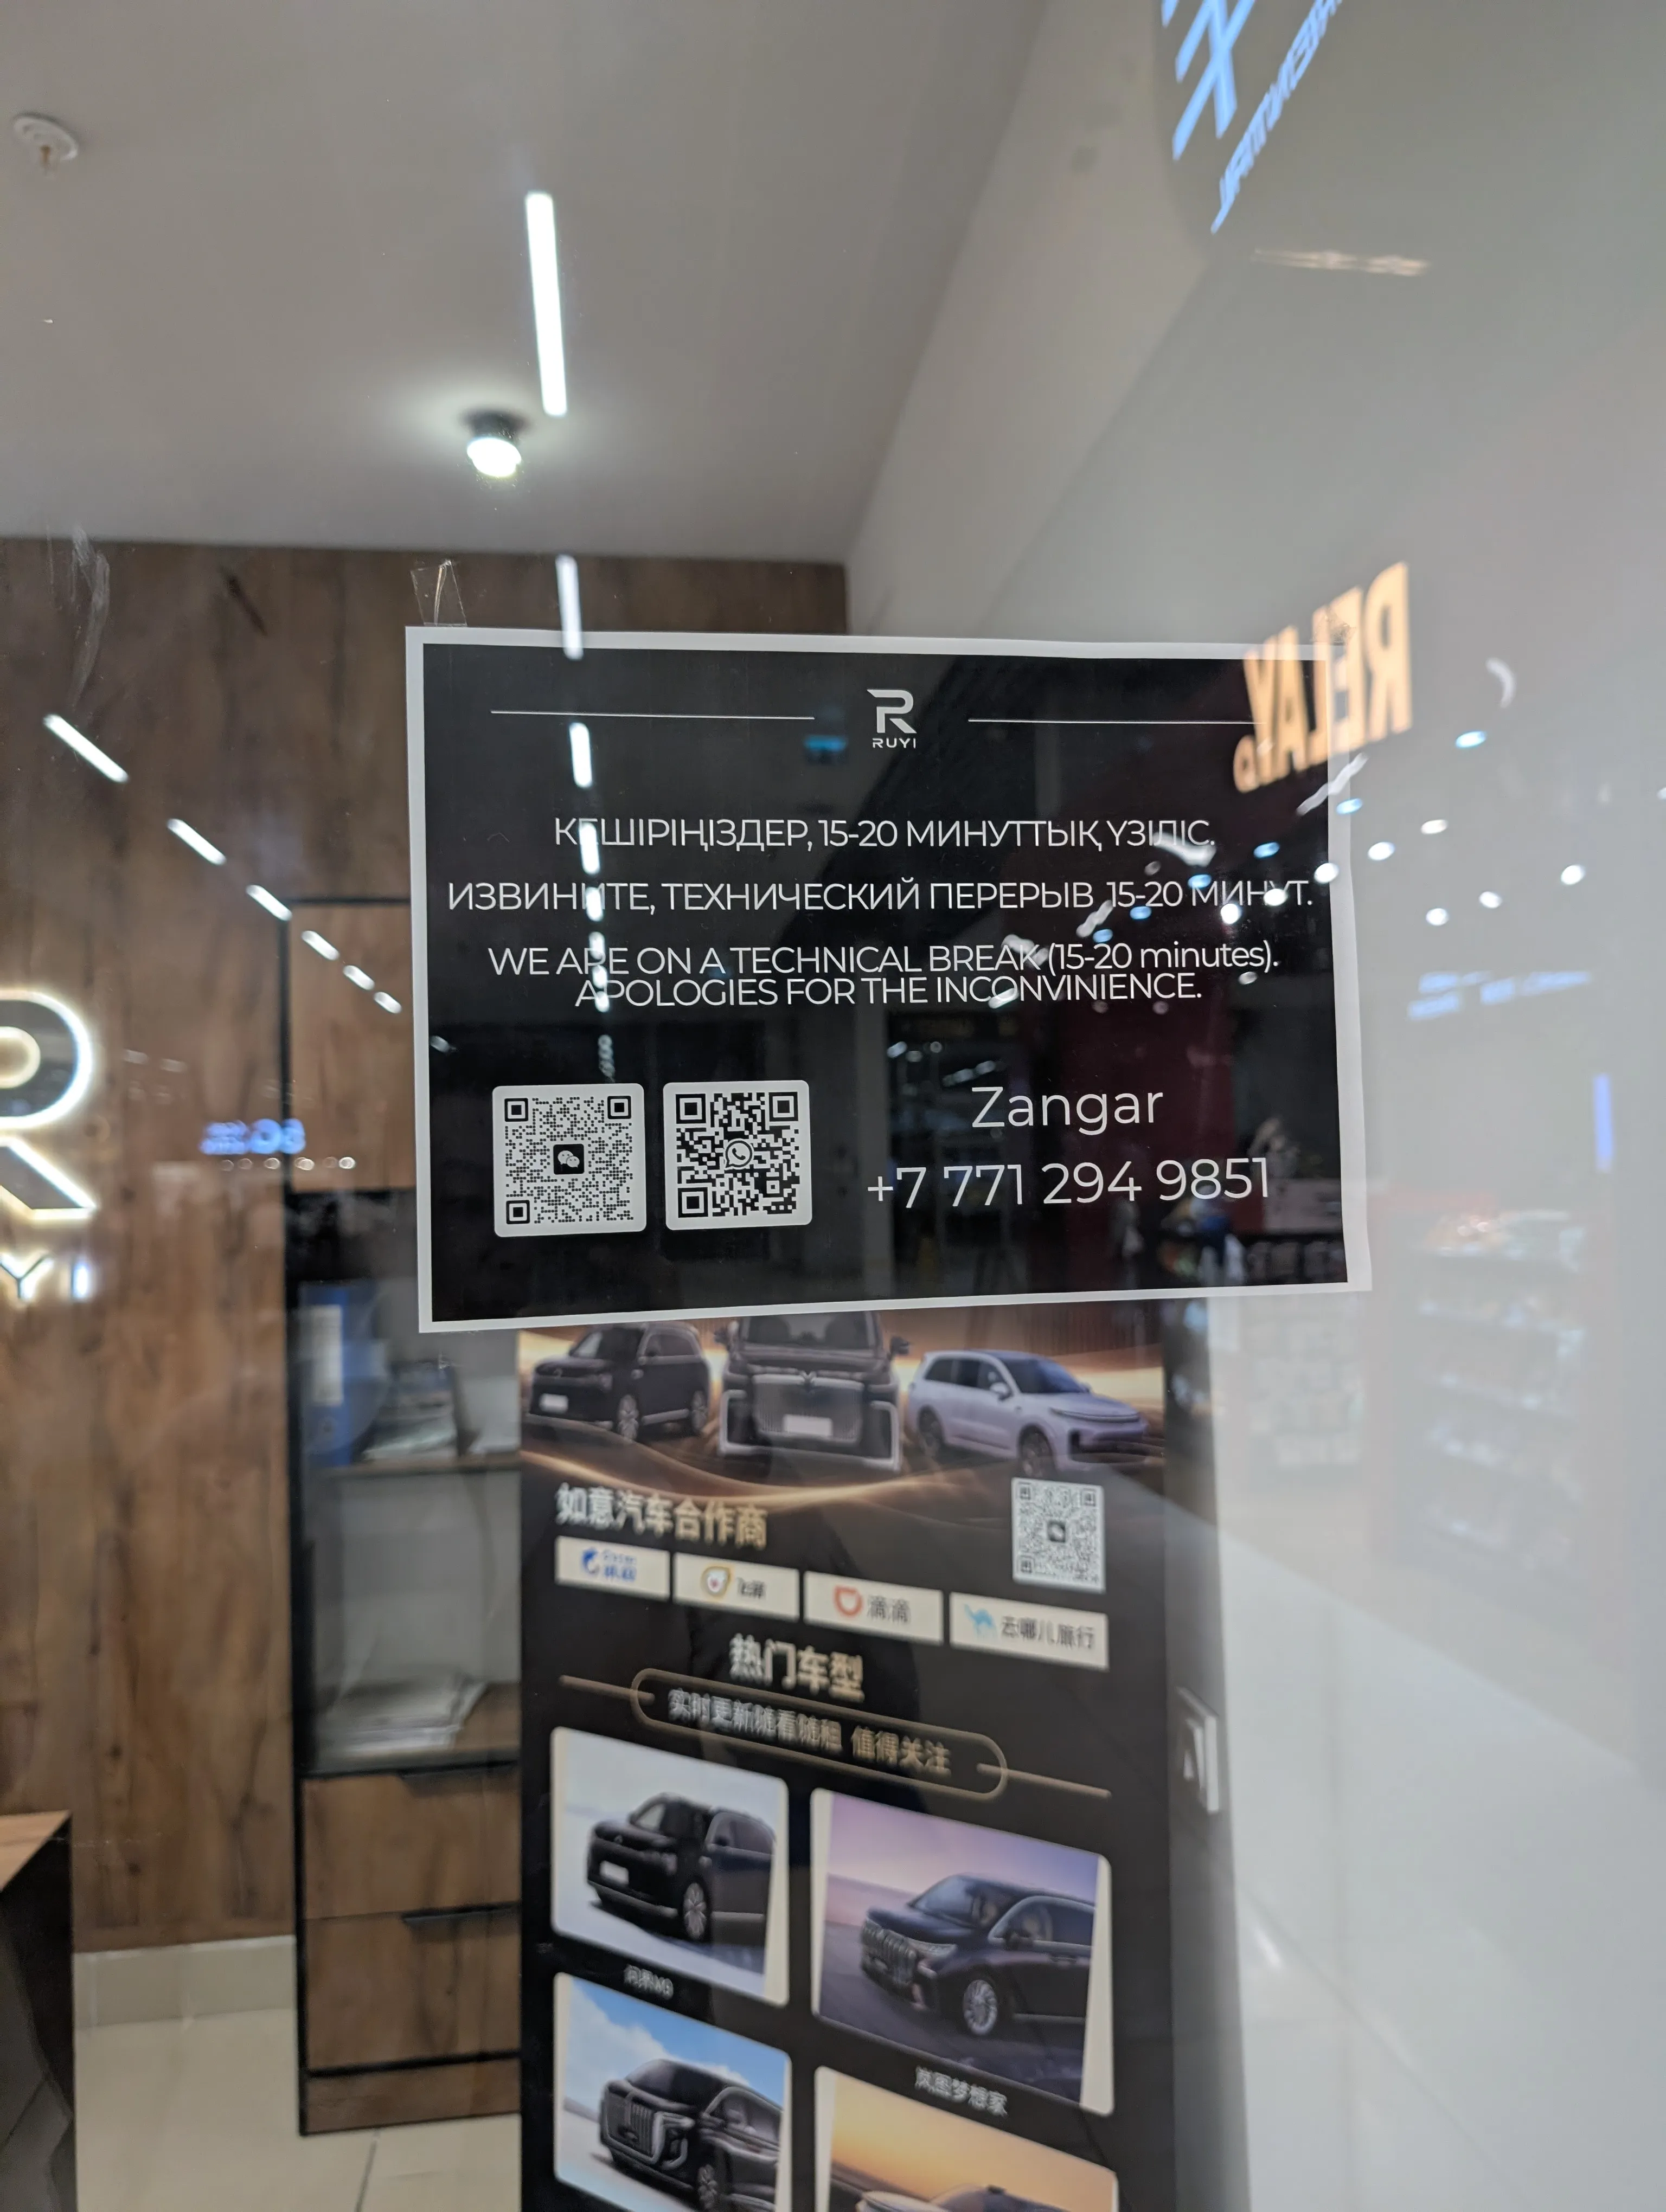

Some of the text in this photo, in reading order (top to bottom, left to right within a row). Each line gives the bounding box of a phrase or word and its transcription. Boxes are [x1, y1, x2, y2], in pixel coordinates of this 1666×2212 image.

[872, 738, 917, 749] RUYI
[818, 819, 898, 847] 15-20
[907, 820, 1102, 851] МИНУТТЫҚ
[661, 878, 919, 911] ТЕХНИЧЕСКИЙ
[930, 882, 1093, 910] ПЕРЕРЫВ
[1106, 880, 1183, 908] 15-20
[488, 940, 1279, 975] WE ARE ON A TECHNICAL BREAK (15-20 minutes).
[575, 973, 1202, 1007] APOLOGIES FOR THE INCONVINIENCE.
[971, 1086, 1164, 1136] Zangar
[868, 1156, 1269, 1208] +7 771 294 9851
[556, 1483, 768, 1552] 如意汽车合作商
[728, 1633, 865, 1703] 热门车型
[851, 1725, 952, 1777] 值得关注
